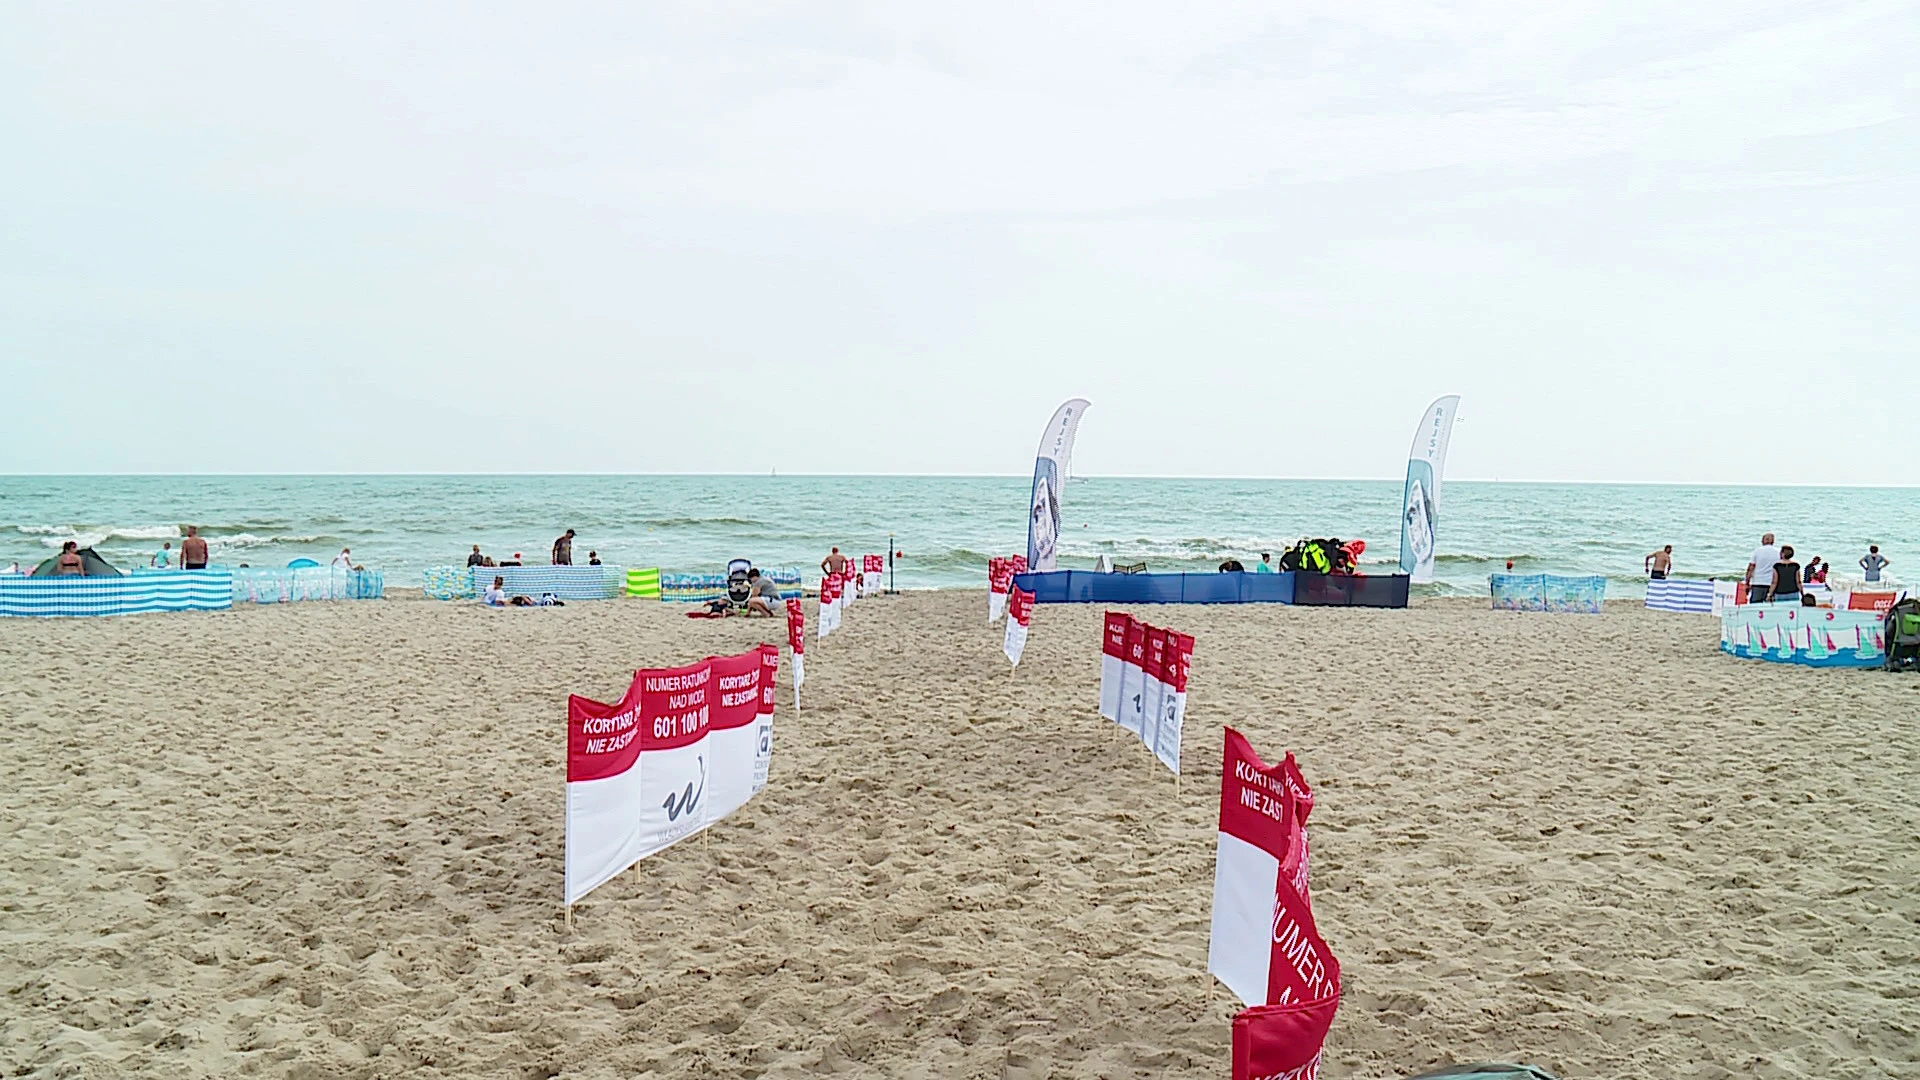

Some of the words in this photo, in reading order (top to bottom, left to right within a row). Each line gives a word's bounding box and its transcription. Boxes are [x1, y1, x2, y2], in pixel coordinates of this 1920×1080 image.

[1053, 407, 1073, 456] REJSY
[1427, 407, 1443, 457] REJSY
[646, 676, 681, 693] NUMER
[669, 694, 688, 710] NAD
[583, 710, 634, 734] KORYTARZ
[653, 714, 677, 738] 601
[681, 709, 698, 735] 100
[585, 738, 608, 755] NIE
[1240, 785, 1260, 811] NIE
